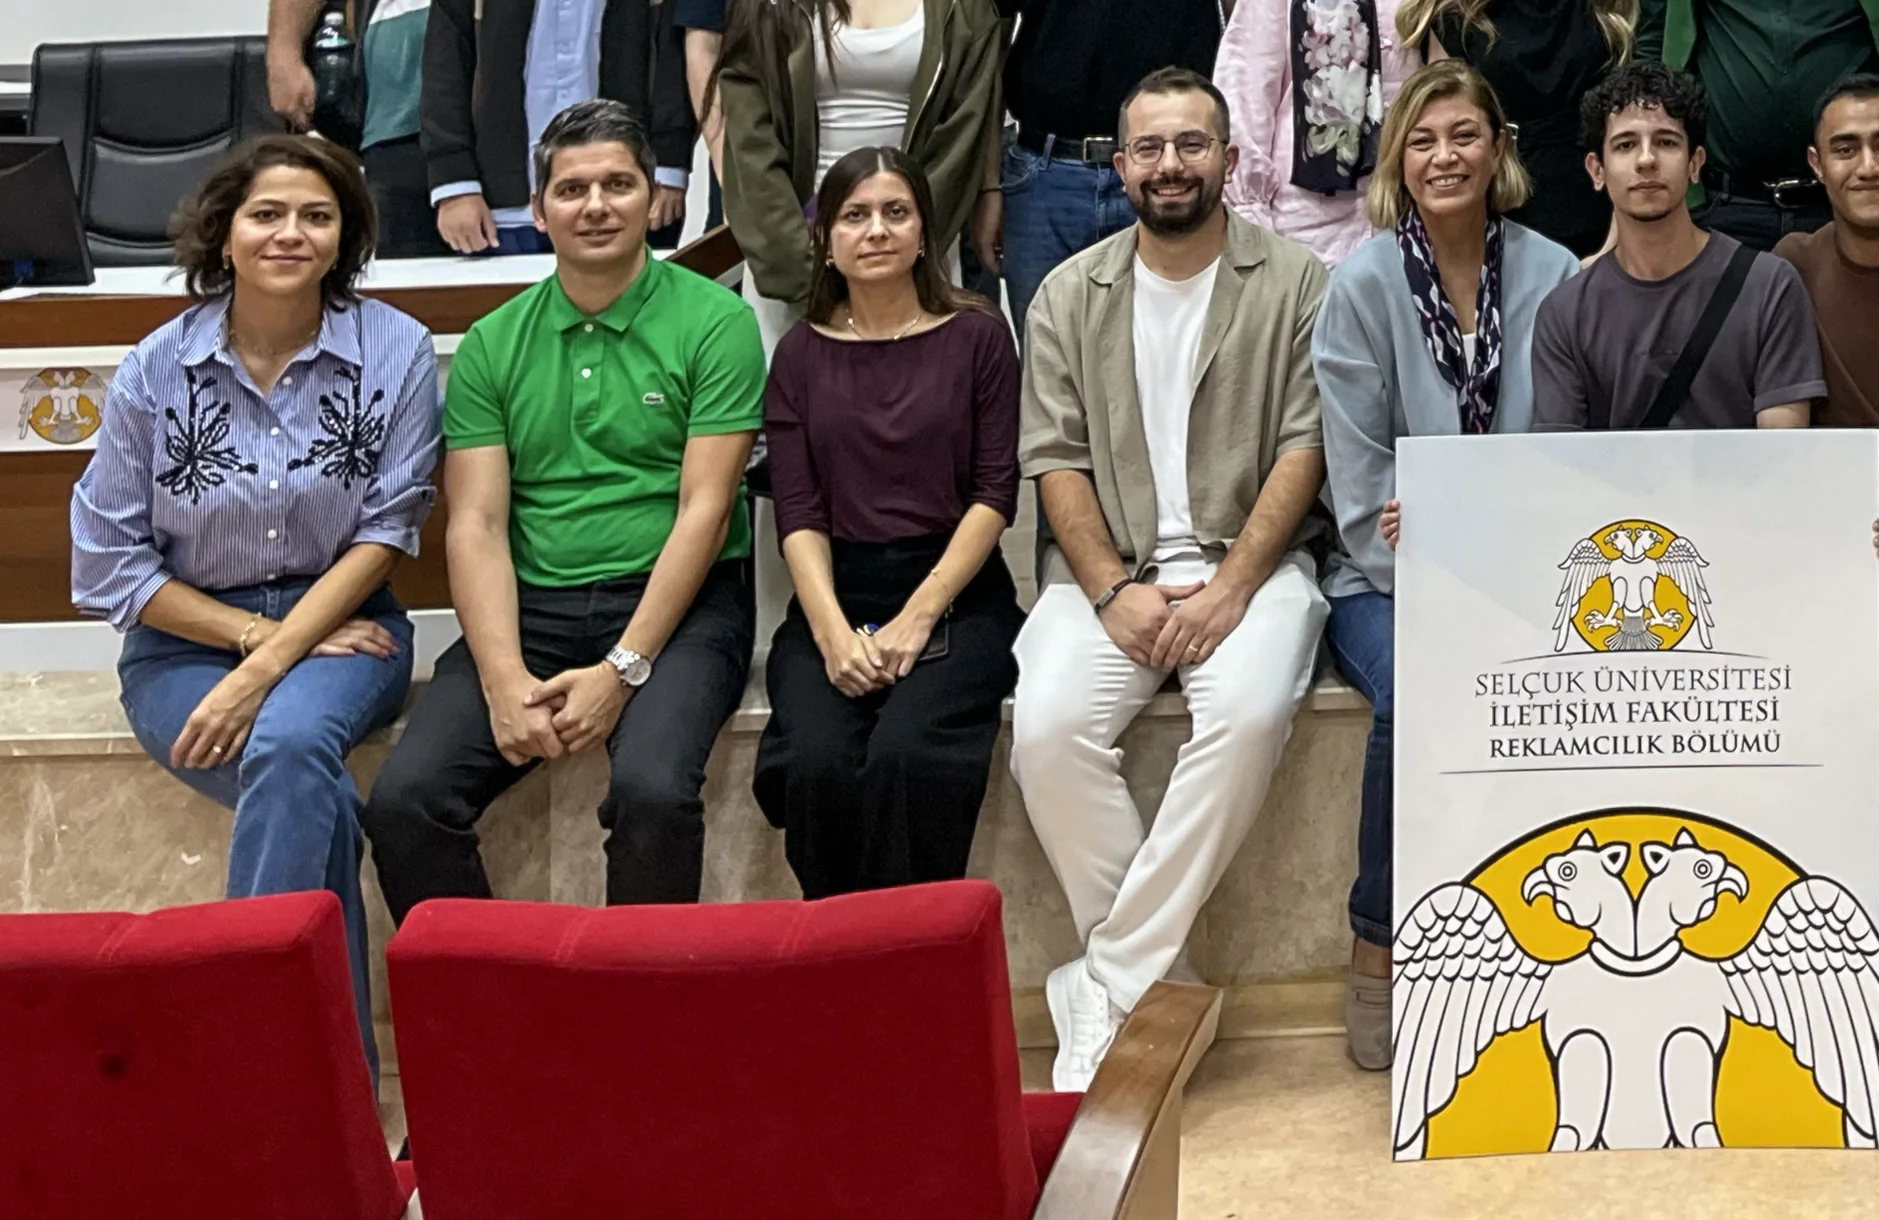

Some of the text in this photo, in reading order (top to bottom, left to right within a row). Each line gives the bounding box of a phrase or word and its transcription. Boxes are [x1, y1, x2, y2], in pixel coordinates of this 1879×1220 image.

[1475, 664, 1792, 700] SELÇUK ÜNİVERSİTESİ
[1488, 695, 1781, 731] İLETİŞİM FAKÜLTESİ
[1488, 729, 1781, 759] REKLAMCILIK BÖLÜMÜ
